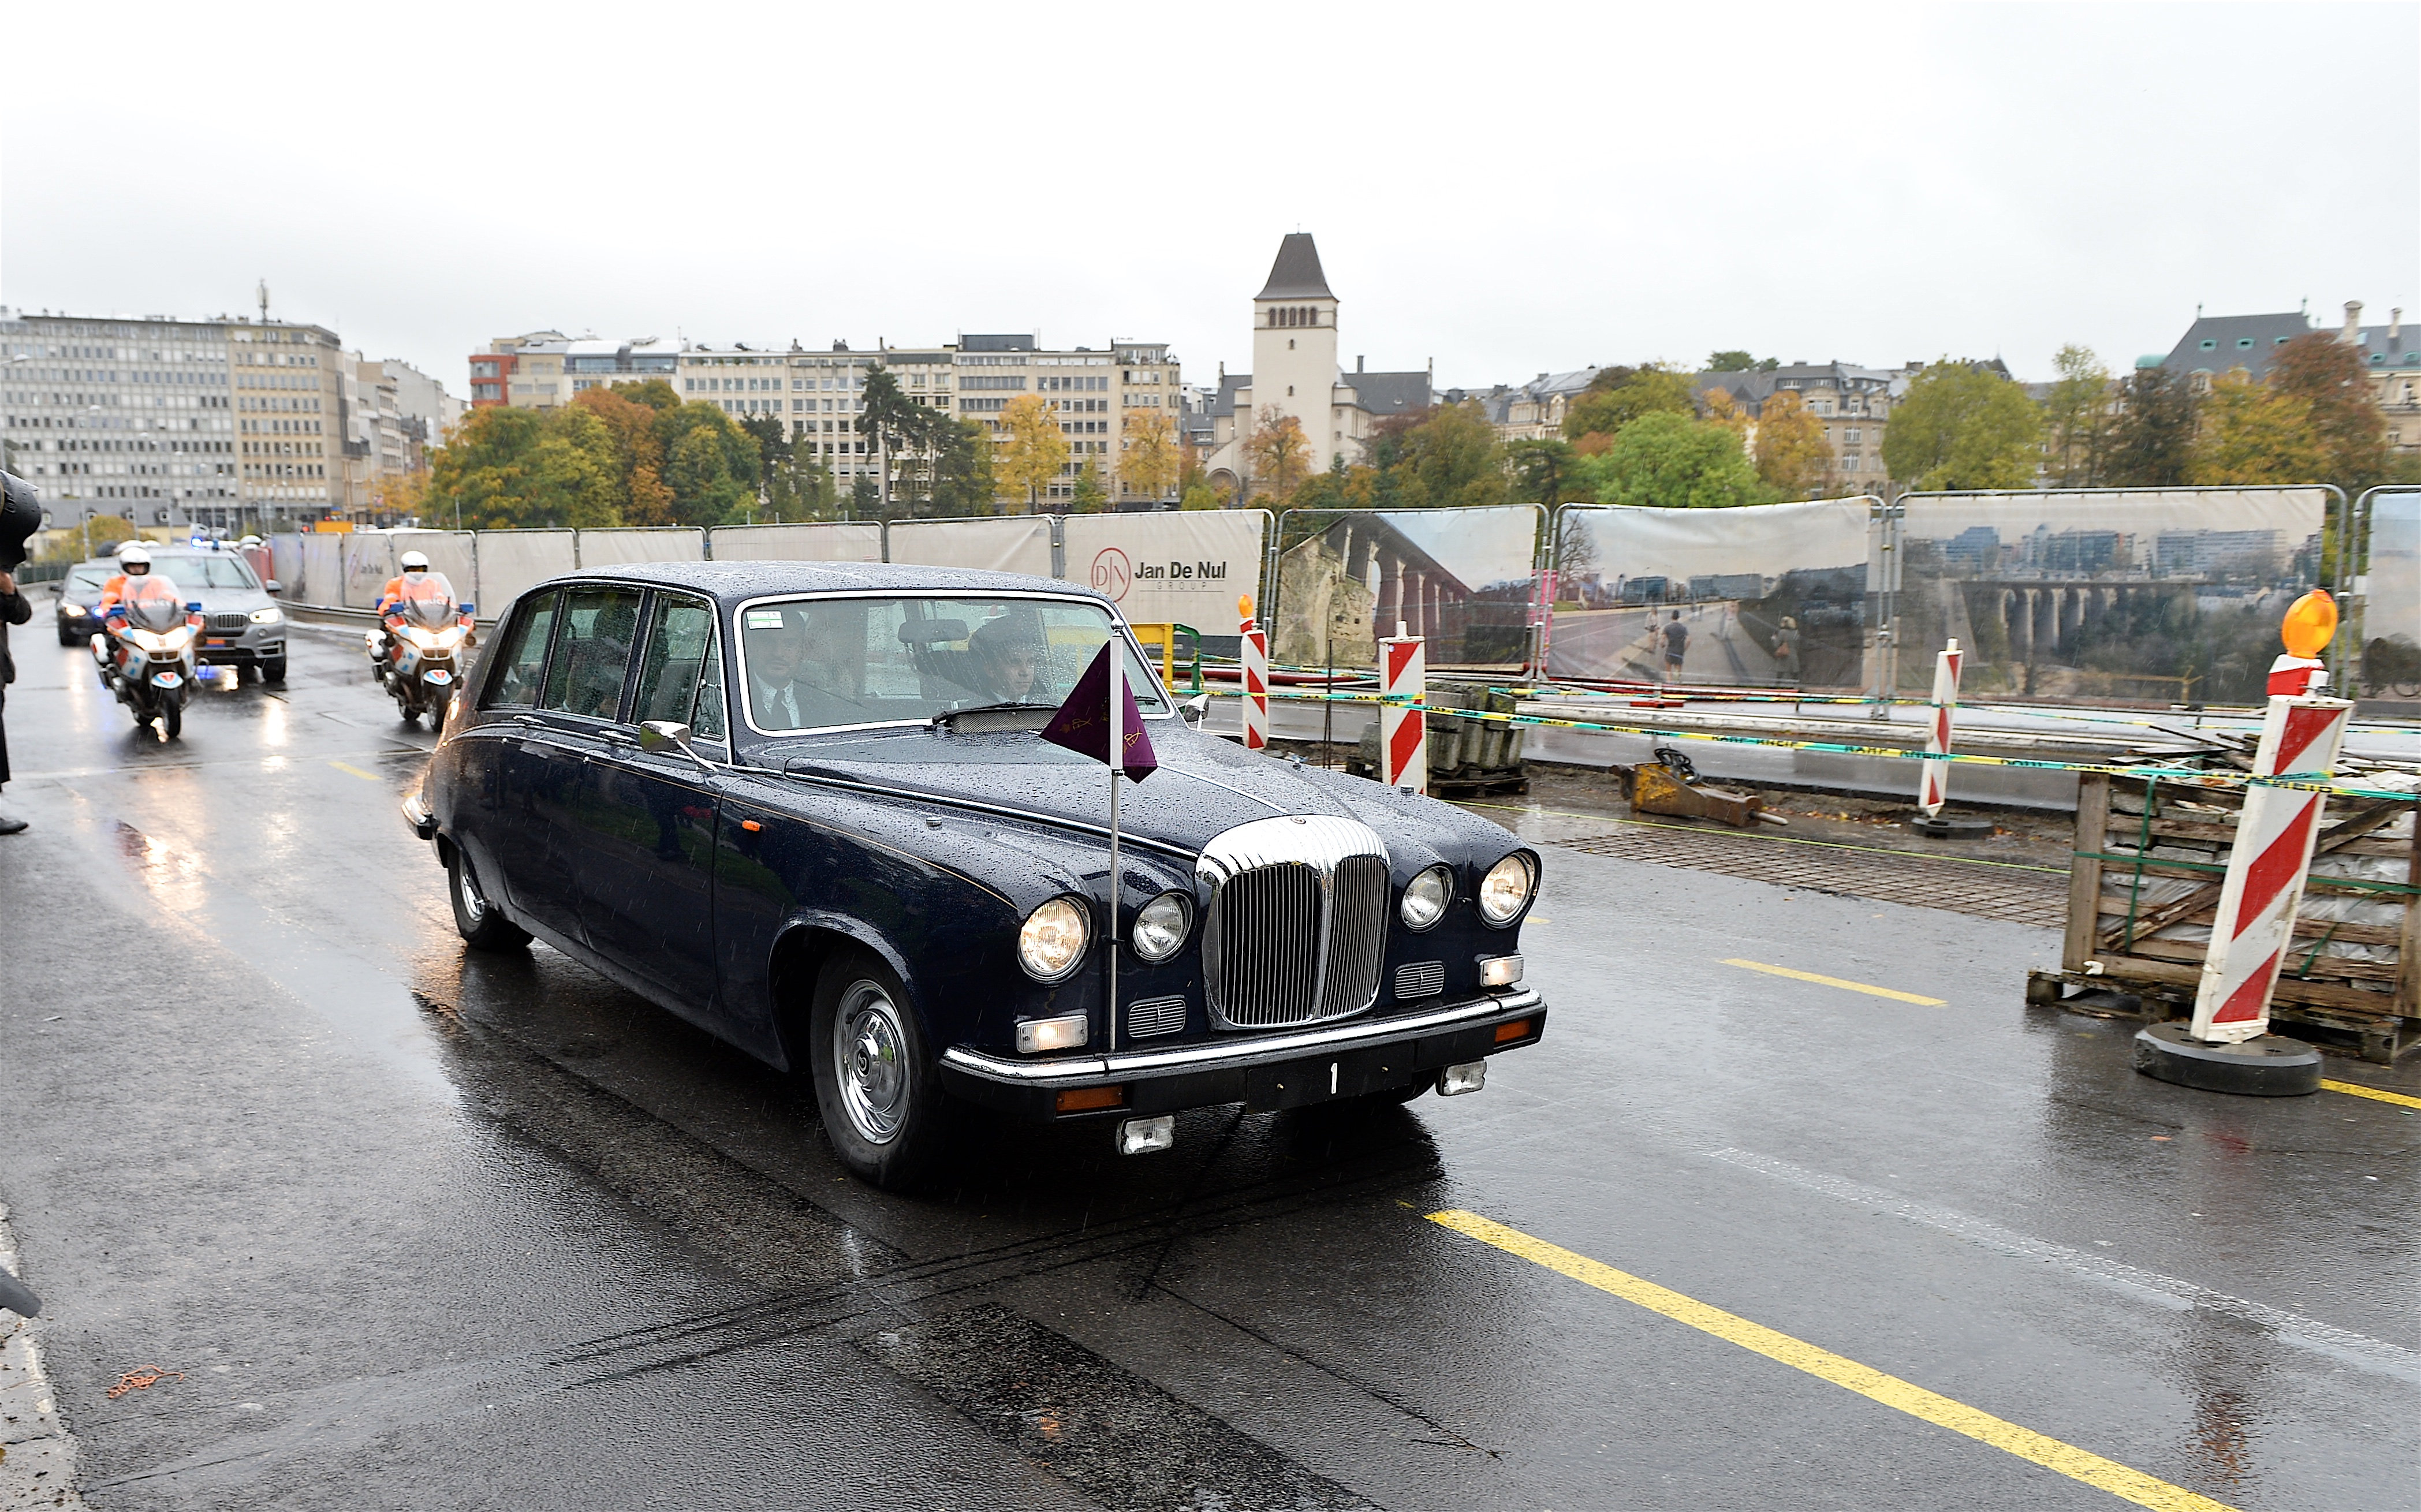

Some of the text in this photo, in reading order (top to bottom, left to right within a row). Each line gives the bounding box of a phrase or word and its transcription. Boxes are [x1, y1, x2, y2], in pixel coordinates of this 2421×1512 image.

[1135, 561, 1226, 578] Jan De Nul
[1157, 582, 1207, 590] GROUP
[1330, 1063, 1338, 1094] 1
